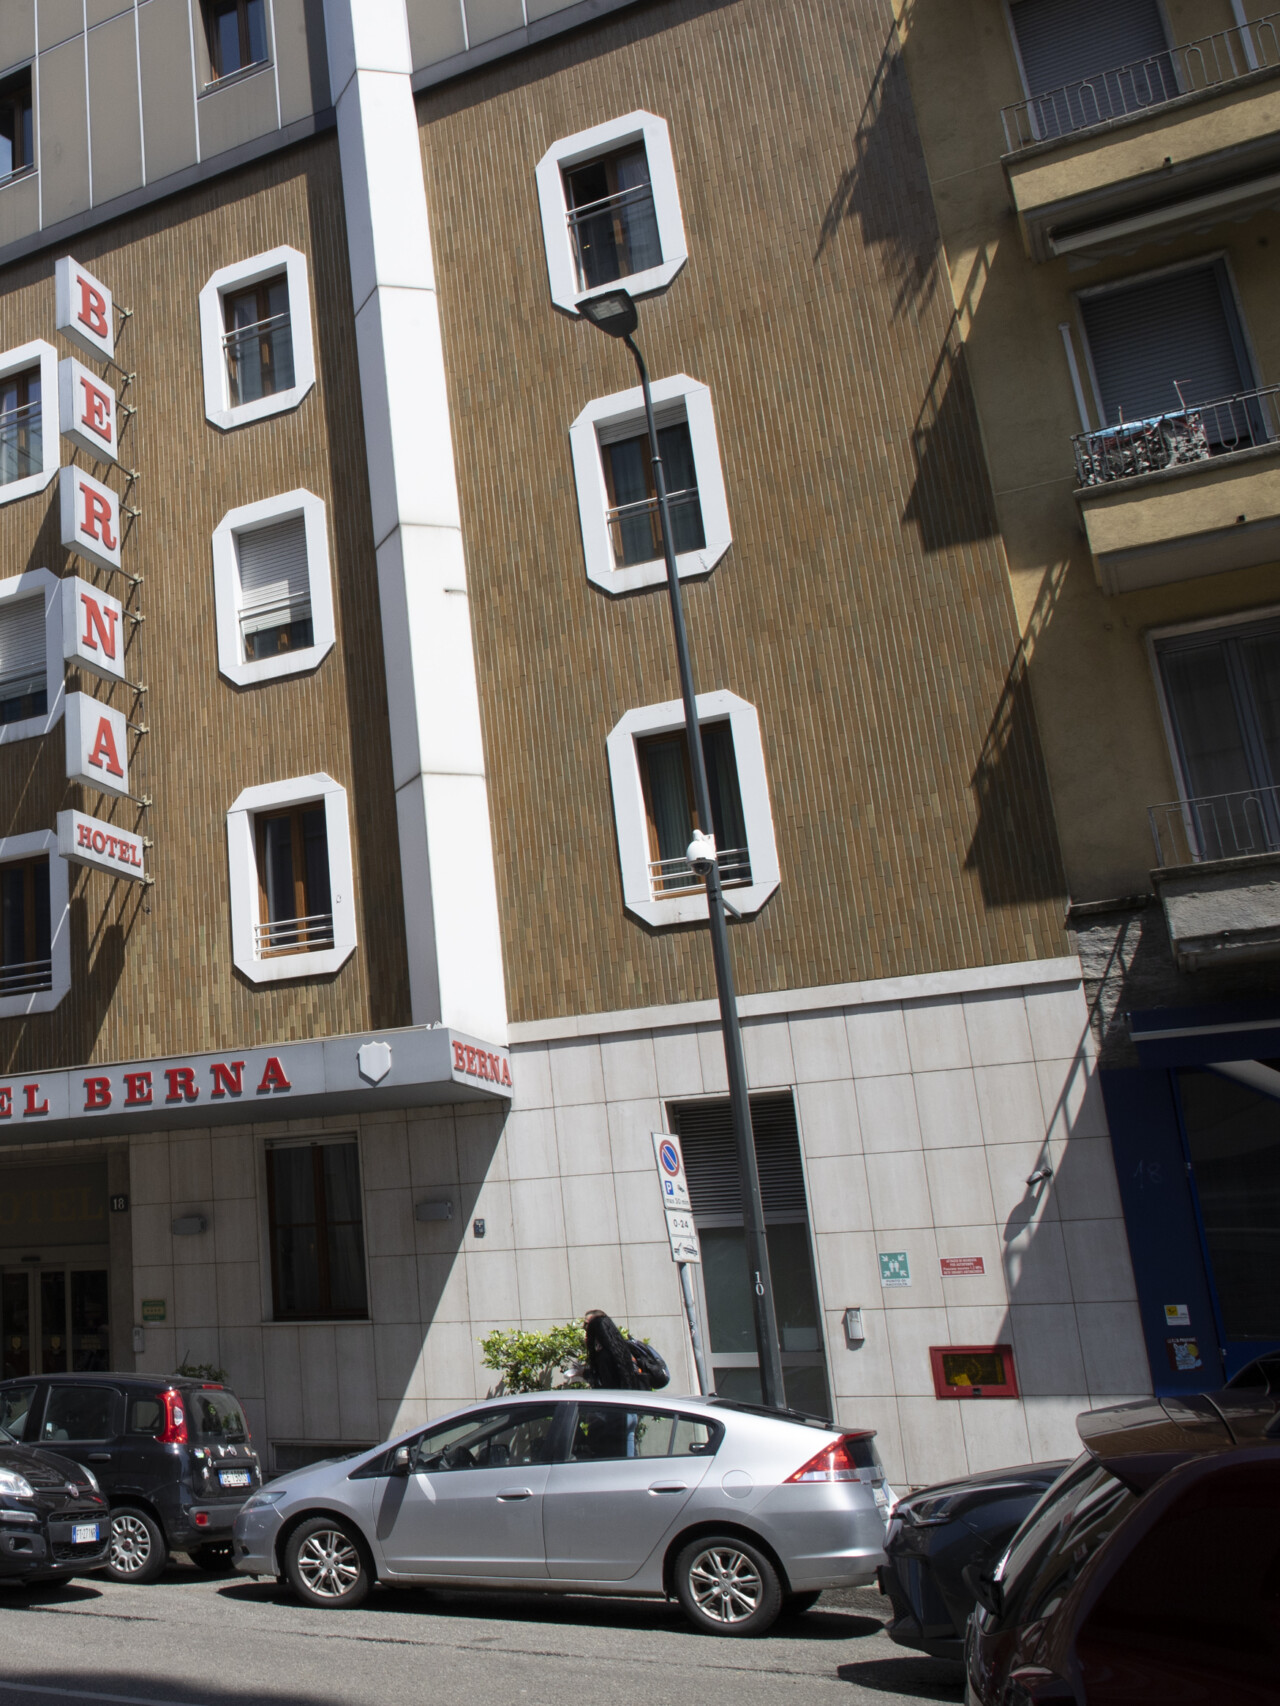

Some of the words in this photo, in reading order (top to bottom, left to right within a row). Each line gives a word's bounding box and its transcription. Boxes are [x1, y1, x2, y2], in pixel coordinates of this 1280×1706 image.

[76, 274, 124, 778] BERNA
[77, 824, 142, 867] HOTEL
[83, 1057, 292, 1109] BERNA
[452, 1040, 513, 1086] BERNA
[113, 1197, 125, 1210] 18
[673, 1219, 689, 1229] 0-24
